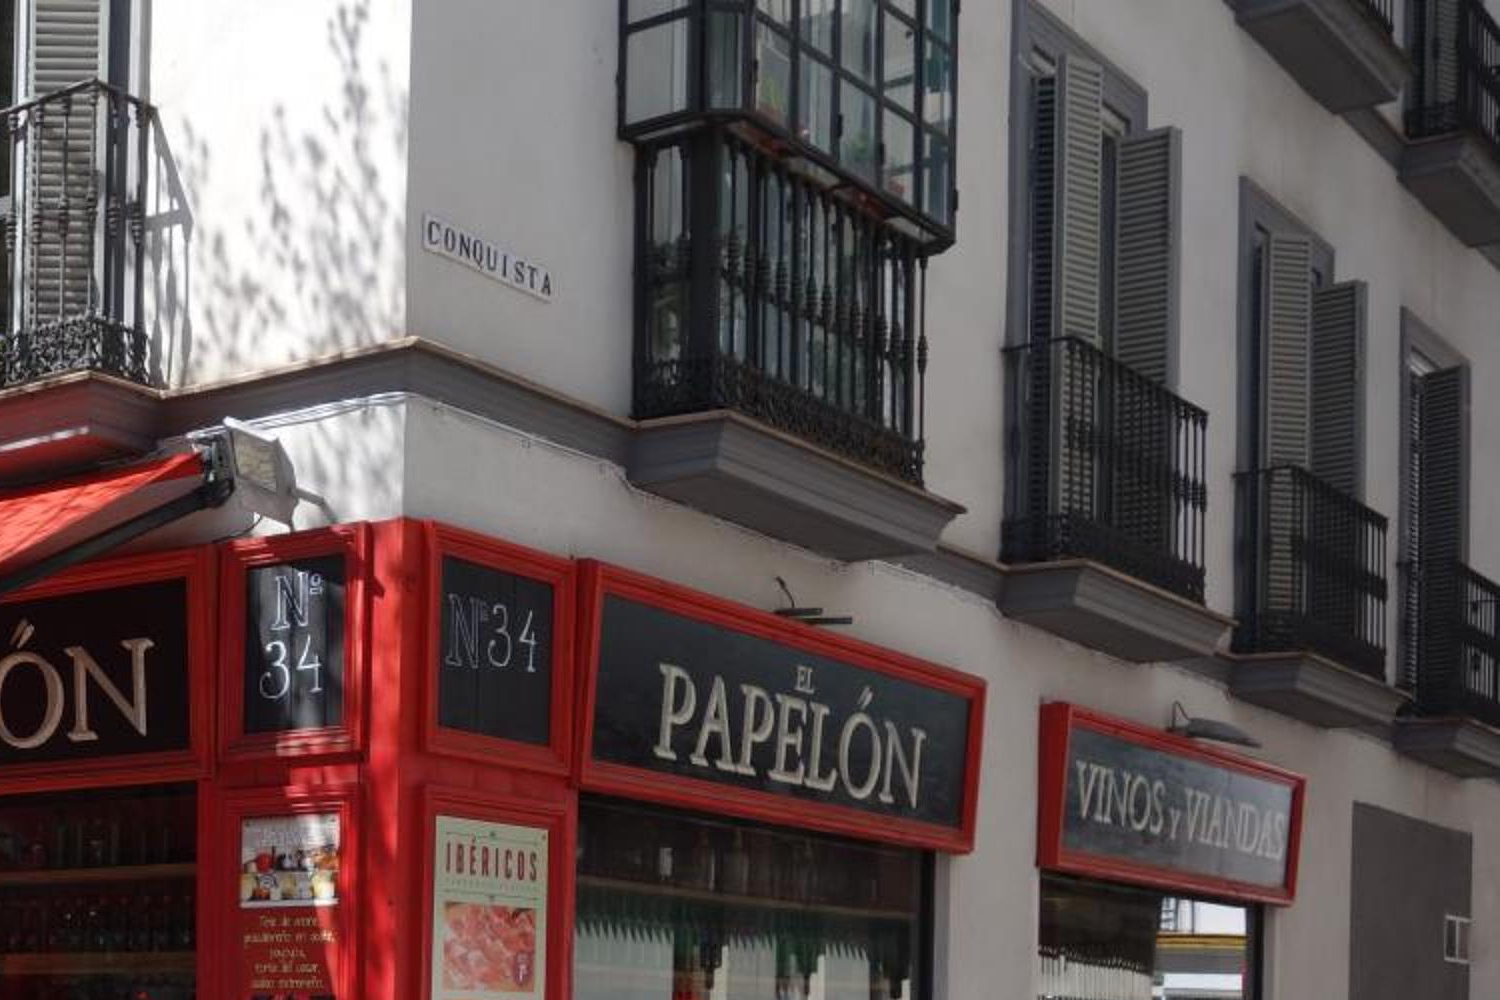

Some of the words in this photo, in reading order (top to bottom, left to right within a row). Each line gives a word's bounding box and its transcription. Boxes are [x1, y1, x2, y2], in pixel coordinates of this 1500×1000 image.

[427, 220, 551, 296] CONQUISTA
[260, 635, 322, 699] 34
[795, 665, 816, 694] EL
[653, 663, 927, 809] PAPELÓN
[1076, 760, 1166, 835] VINOS
[1185, 786, 1285, 860] VIANDAS
[445, 835, 537, 882] IBÉRICOS
